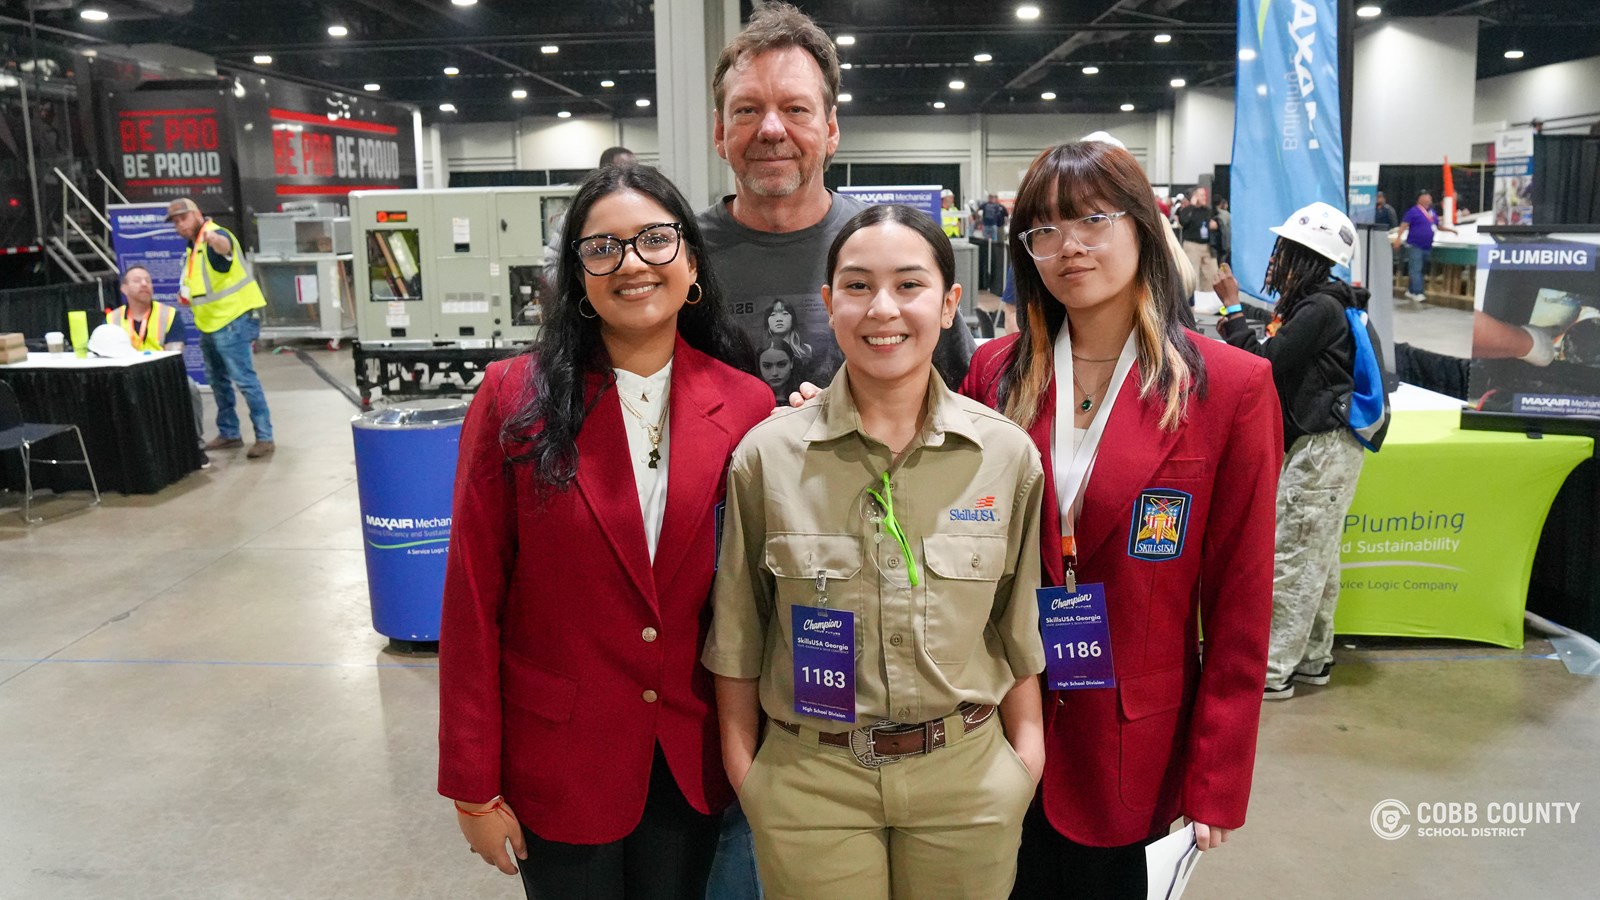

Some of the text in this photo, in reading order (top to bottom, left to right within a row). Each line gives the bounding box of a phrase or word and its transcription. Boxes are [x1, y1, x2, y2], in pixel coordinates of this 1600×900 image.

[120, 117, 218, 152] BE PRO
[272, 127, 400, 180] BE PRO BE PROUD
[123, 151, 220, 178] BE PROUD
[851, 192, 932, 202] MAXAIR Mechanical
[1488, 249, 1588, 265] PLUMBING
[1521, 397, 1570, 407] MAXAIR
[950, 508, 996, 521] SkillsUSA
[1343, 510, 1465, 534] Plumbing
[366, 514, 452, 531] MAXAIR Mechan
[424, 528, 451, 537] Sustaina
[431, 547, 444, 555] Logic
[1357, 536, 1461, 553] Sustainability
[1340, 579, 1459, 592] vice Logic Company
[1051, 593, 1092, 610] Champion
[803, 618, 842, 631] Champion
[1045, 616, 1075, 624] SkillsUSA
[797, 637, 824, 647] SkillsUSA
[824, 641, 849, 651] Georgia
[1053, 640, 1102, 659] 1186
[801, 666, 846, 689] 1183
[828, 710, 846, 719] Division
